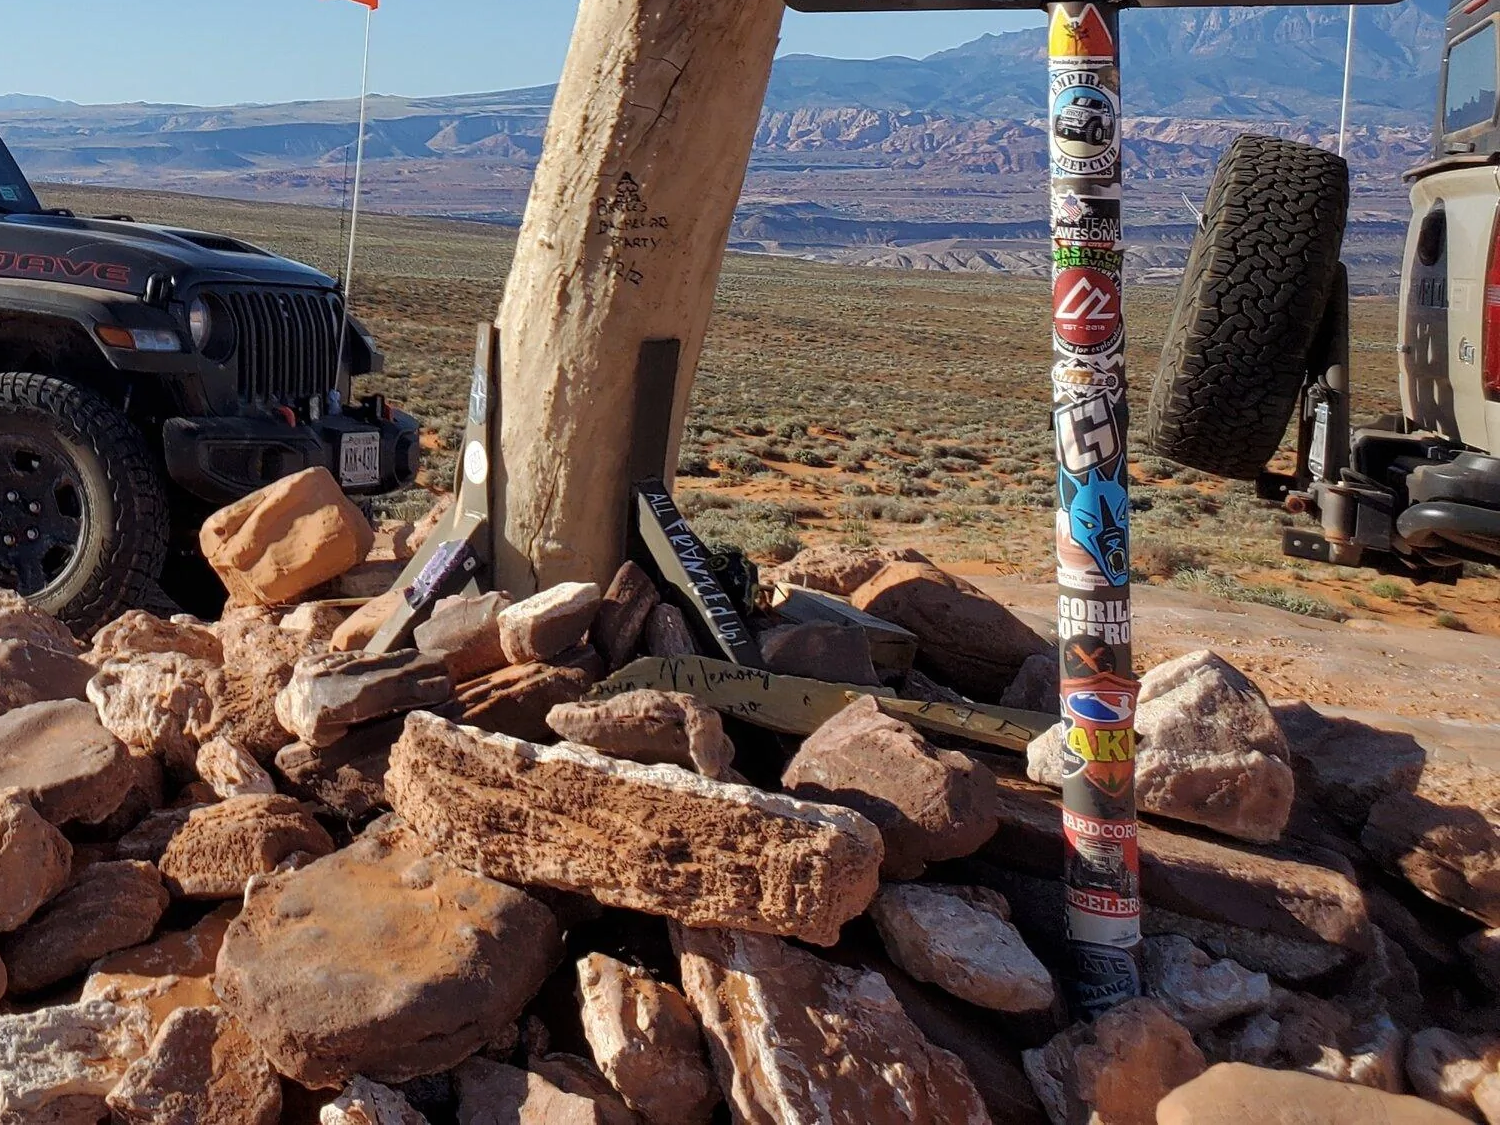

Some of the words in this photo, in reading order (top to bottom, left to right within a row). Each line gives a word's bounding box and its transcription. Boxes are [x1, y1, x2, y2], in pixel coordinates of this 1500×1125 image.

[1057, 154, 1087, 172] JEEP
[1088, 146, 1118, 172] CLUB
[1083, 216, 1120, 230] TEAM
[1055, 226, 1122, 242] AWESOME
[1053, 246, 1123, 266] WASATCH
[1056, 257, 1120, 272] BOULEVARD
[646, 493, 674, 519] ALL
[1067, 887, 1140, 914] HEELERS
